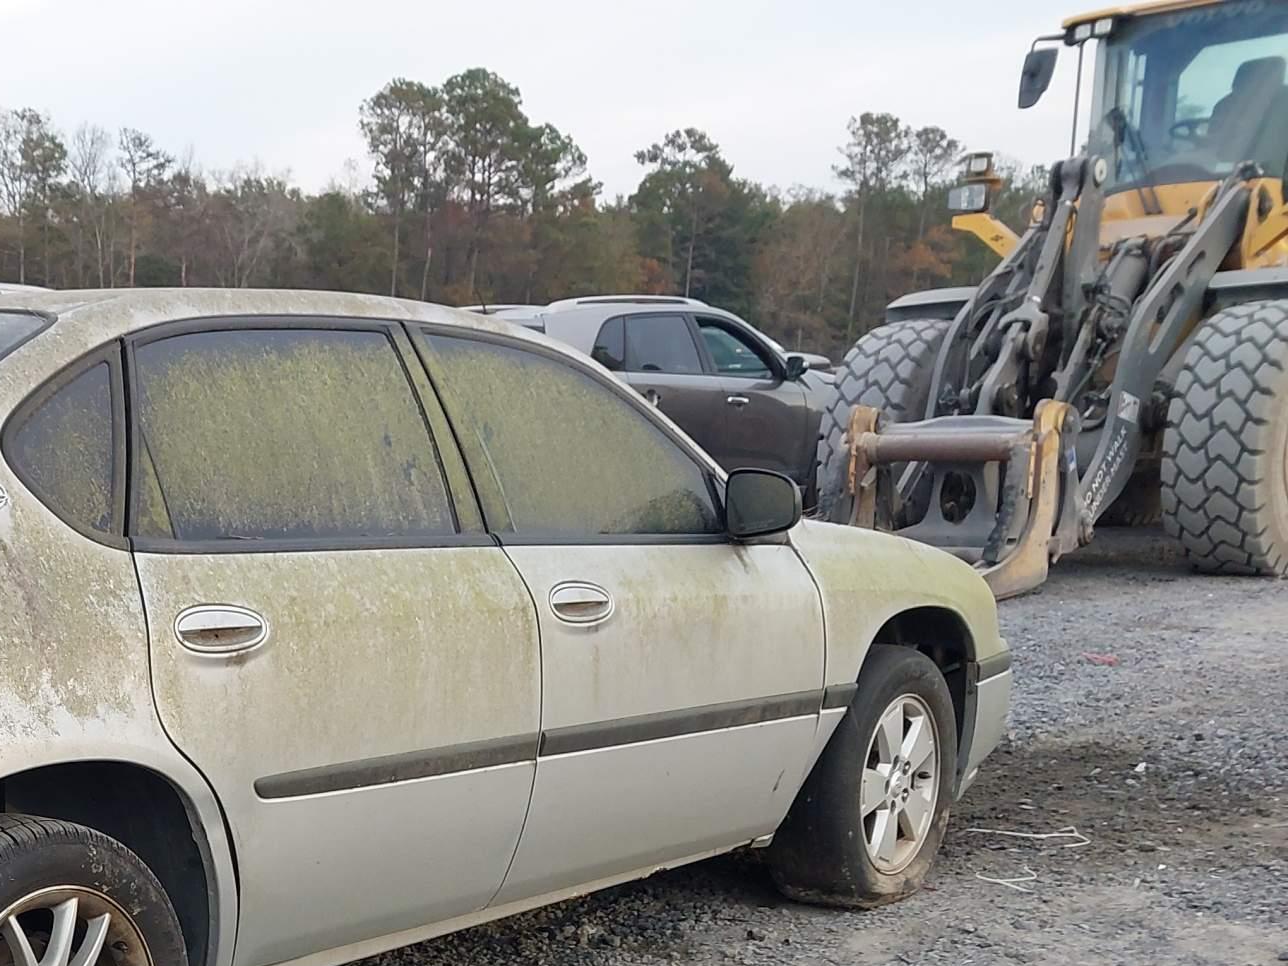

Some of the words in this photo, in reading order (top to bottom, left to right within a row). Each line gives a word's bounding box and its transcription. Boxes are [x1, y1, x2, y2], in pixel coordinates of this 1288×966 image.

[1088, 475, 1111, 518] UNDER
[1111, 440, 1128, 477] MAST
[1092, 461, 1107, 491] NOT
[1107, 425, 1127, 462] WALK
